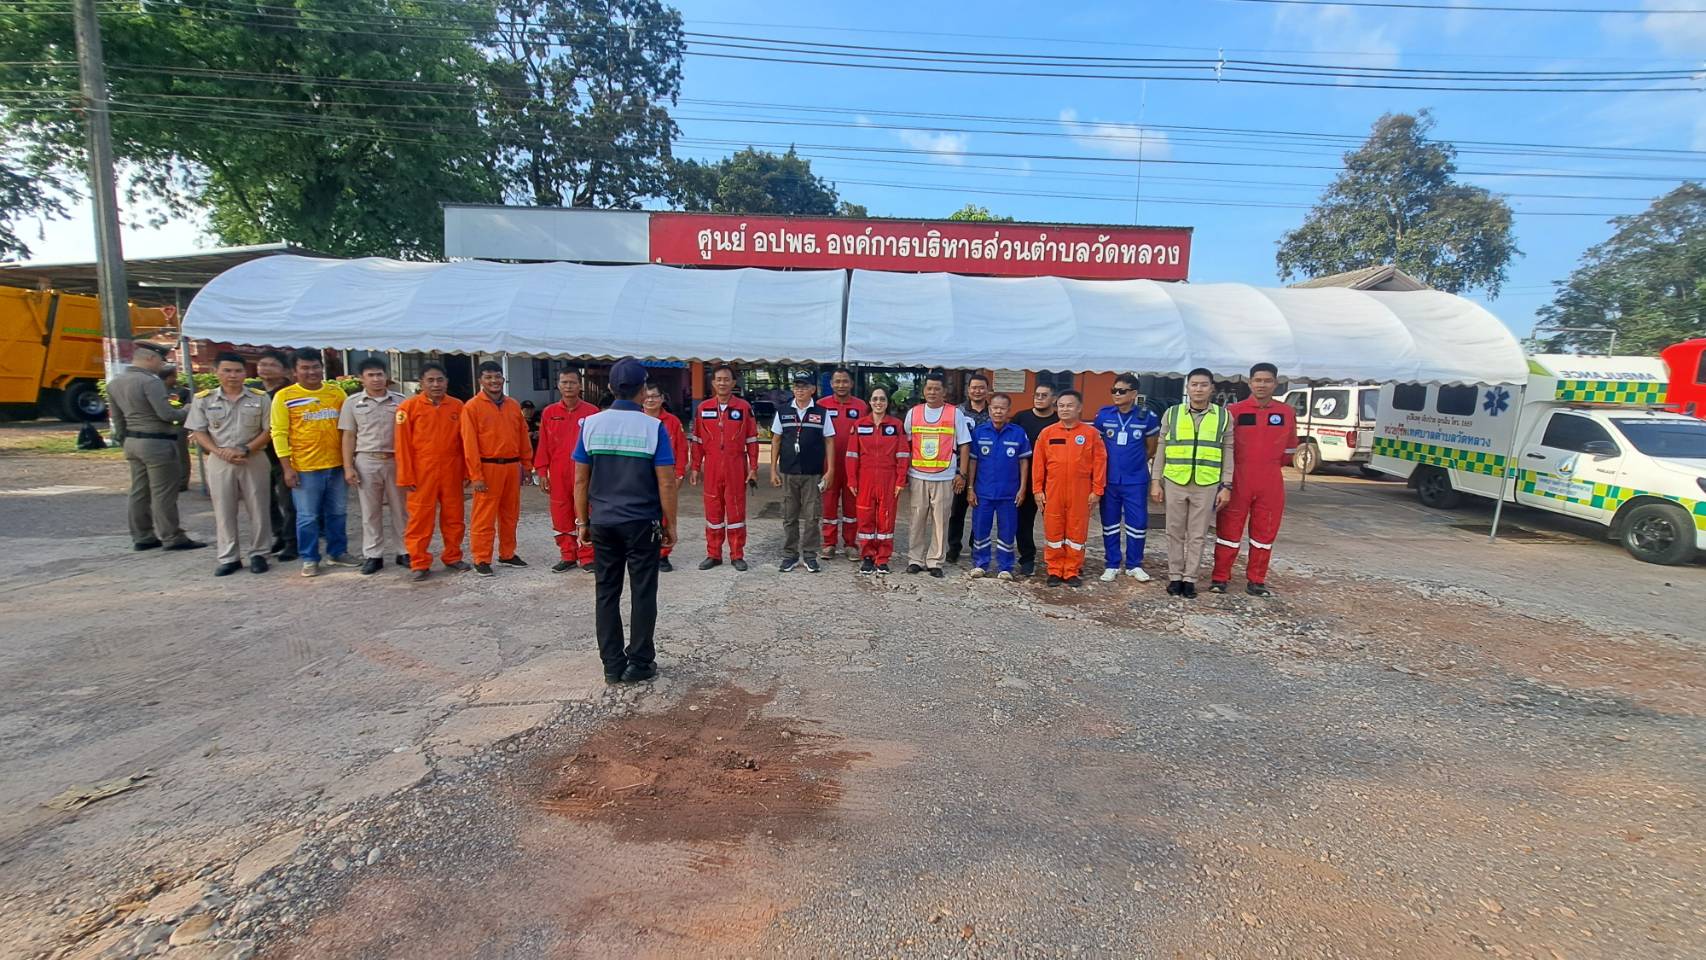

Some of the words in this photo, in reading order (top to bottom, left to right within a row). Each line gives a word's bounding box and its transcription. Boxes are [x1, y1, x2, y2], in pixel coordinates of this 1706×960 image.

[697, 223, 747, 261] ศูนย์
[753, 228, 821, 254] อปพร.
[826, 227, 1180, 265] องค์การบริหารส่วนตำบลวัดหลวง
